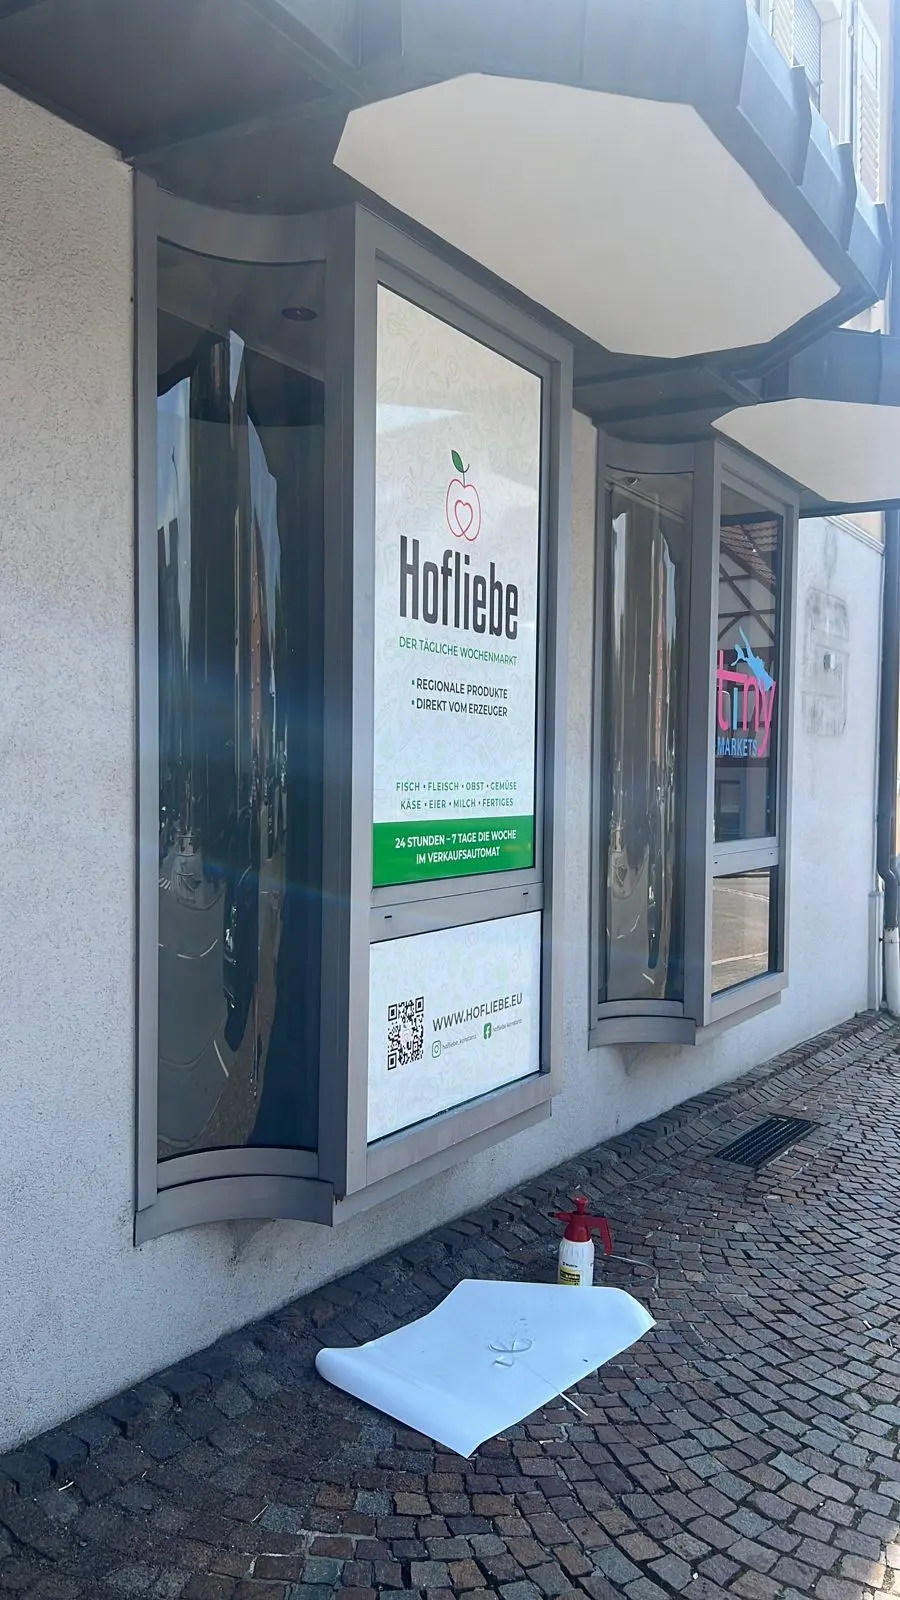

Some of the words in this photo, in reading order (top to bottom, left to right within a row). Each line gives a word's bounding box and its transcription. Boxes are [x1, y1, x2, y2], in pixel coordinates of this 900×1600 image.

[400, 535, 518, 640] Hofliebe
[400, 637, 417, 650] DER
[420, 638, 458, 656] TÄGLICHE
[459, 647, 517, 666] WOCHENMARKT
[417, 678, 465, 694] REGIONALE
[467, 684, 508, 699] PRODUKTE
[417, 698, 447, 712] DIREKT
[449, 700, 467, 713] VOM
[469, 703, 508, 717] ERZEUGER
[716, 650, 776, 757] tiny
[717, 737, 758, 757] MARKETS
[396, 782, 420, 791] FISCH
[428, 782, 459, 791] FLEISCH
[466, 781, 484, 790] OBST
[490, 780, 517, 790] GEMÜSE
[401, 798, 421, 810] KÄSE
[429, 799, 446, 809] EIER
[453, 799, 476, 808] MILCH
[482, 798, 514, 807] FERTIGES
[395, 838, 406, 849] 24
[407, 835, 445, 848] STUNDEN
[452, 834, 457, 844] 7
[458, 832, 477, 843] TAGE
[479, 831, 490, 842] DIE
[491, 830, 517, 841] WOCHE
[416, 853, 426, 865] IM
[427, 847, 500, 864] VERKAUFSAUTOMAT
[433, 993, 523, 1031] WWW.HOFLIEBE.EU
